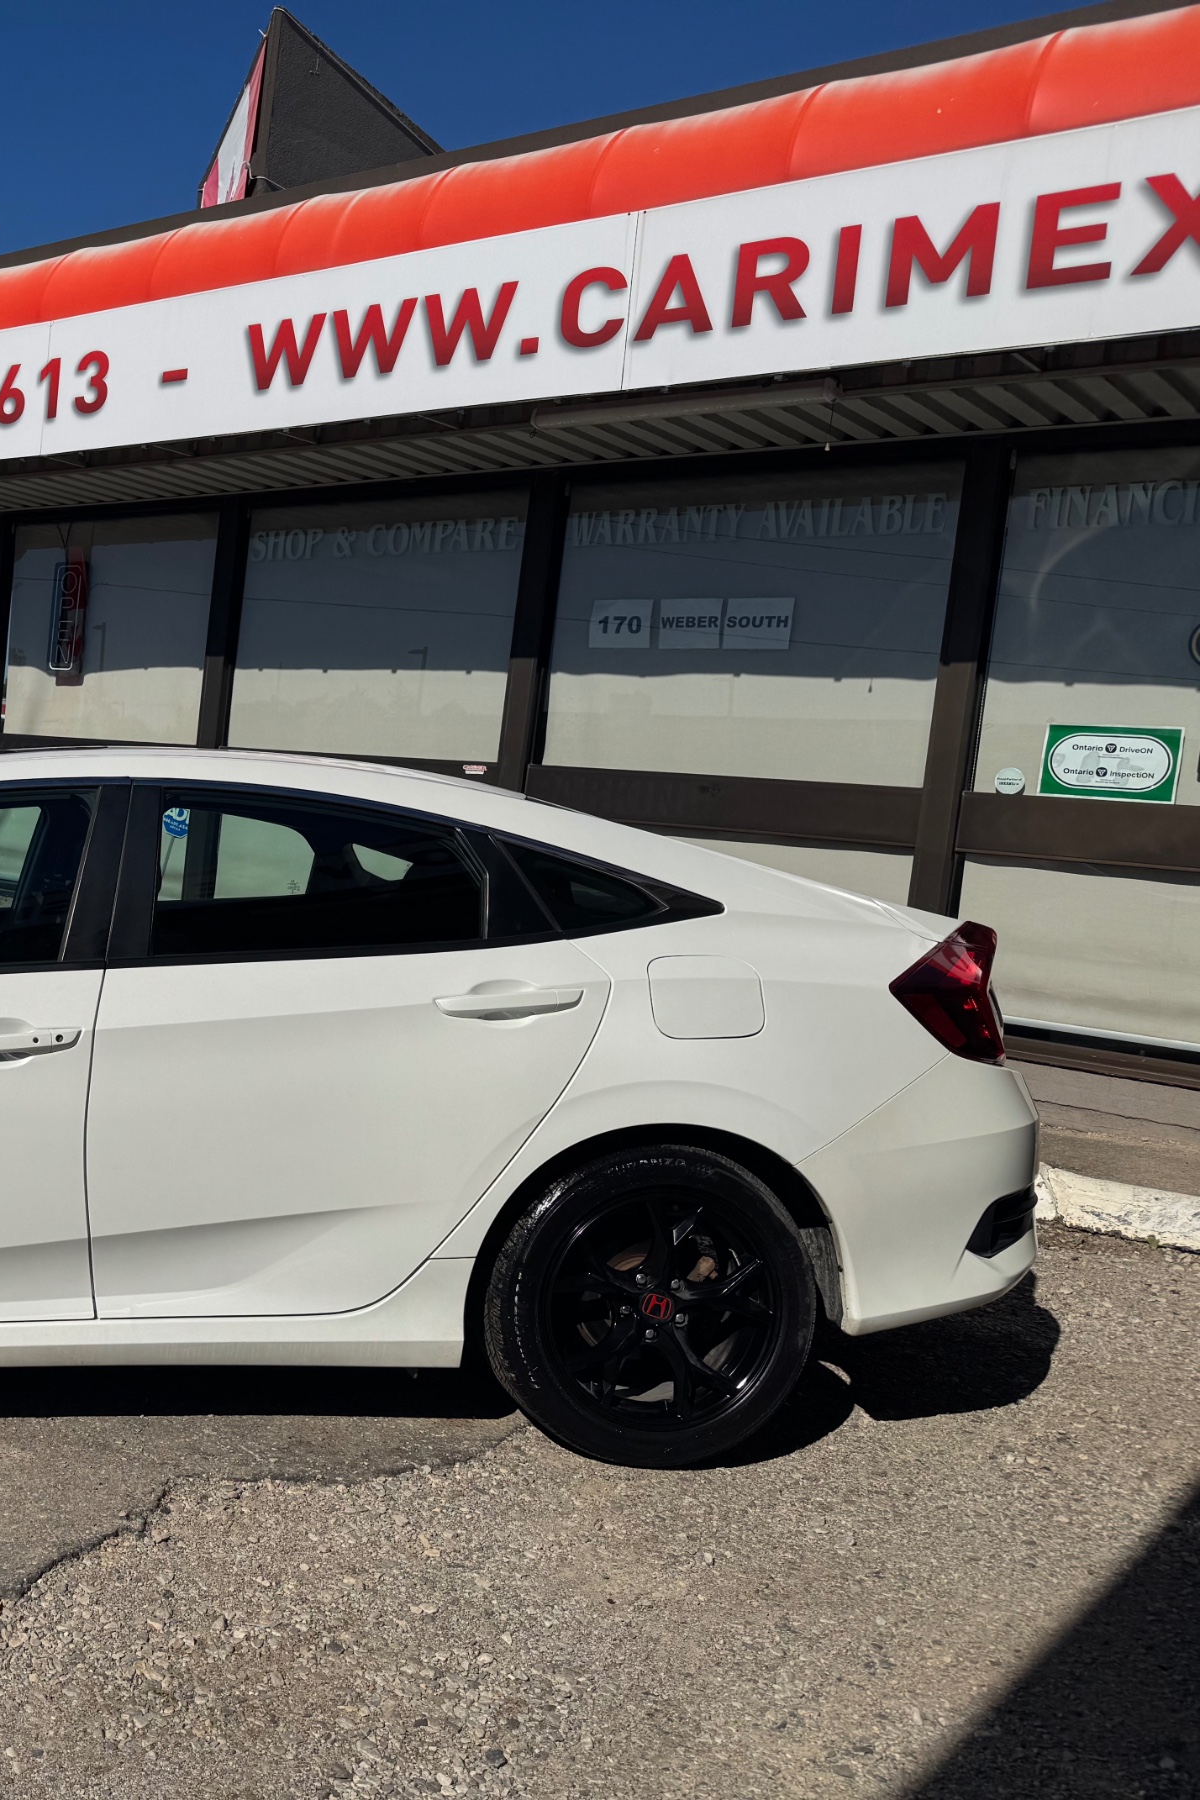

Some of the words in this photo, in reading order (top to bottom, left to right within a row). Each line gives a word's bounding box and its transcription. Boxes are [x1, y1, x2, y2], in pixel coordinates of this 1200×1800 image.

[247, 172, 1200, 390] WWW.CARIMEX
[251, 528, 324, 562] SHOP
[334, 526, 357, 558] &
[367, 516, 520, 557] COMPARE
[571, 503, 748, 547] WARRANTY
[757, 492, 947, 539] AVAILABLE
[55, 571, 78, 664] OPEN
[598, 615, 642, 634] 170
[661, 615, 719, 629] WEBER
[726, 615, 789, 629] SOUTH
[1063, 767, 1094, 776] Ontario
[1072, 743, 1104, 752] Ontario
[1119, 746, 1154, 754] DriveON
